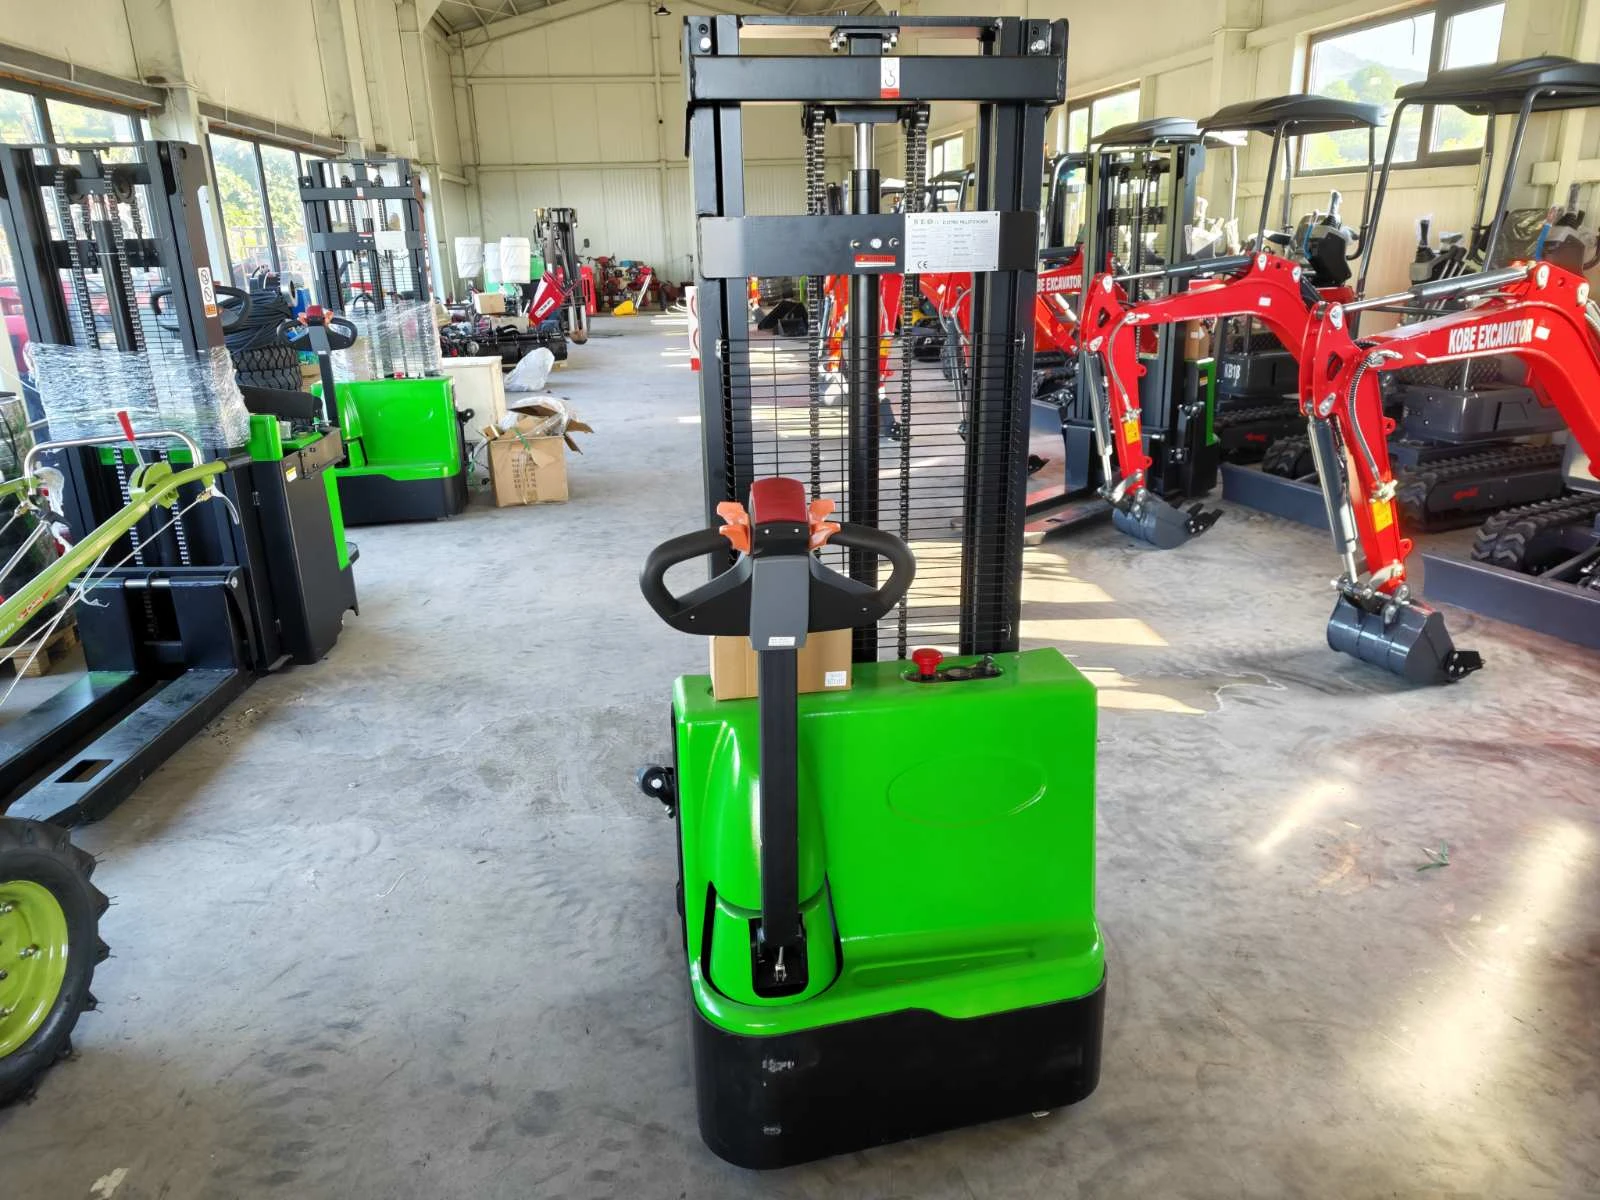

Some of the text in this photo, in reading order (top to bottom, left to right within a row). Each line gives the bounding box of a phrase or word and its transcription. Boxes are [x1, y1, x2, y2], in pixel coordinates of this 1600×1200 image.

[1037, 274, 1082, 292] BE EXCAVATOR
[1448, 318, 1534, 353] KOBE EXCAVATOR
